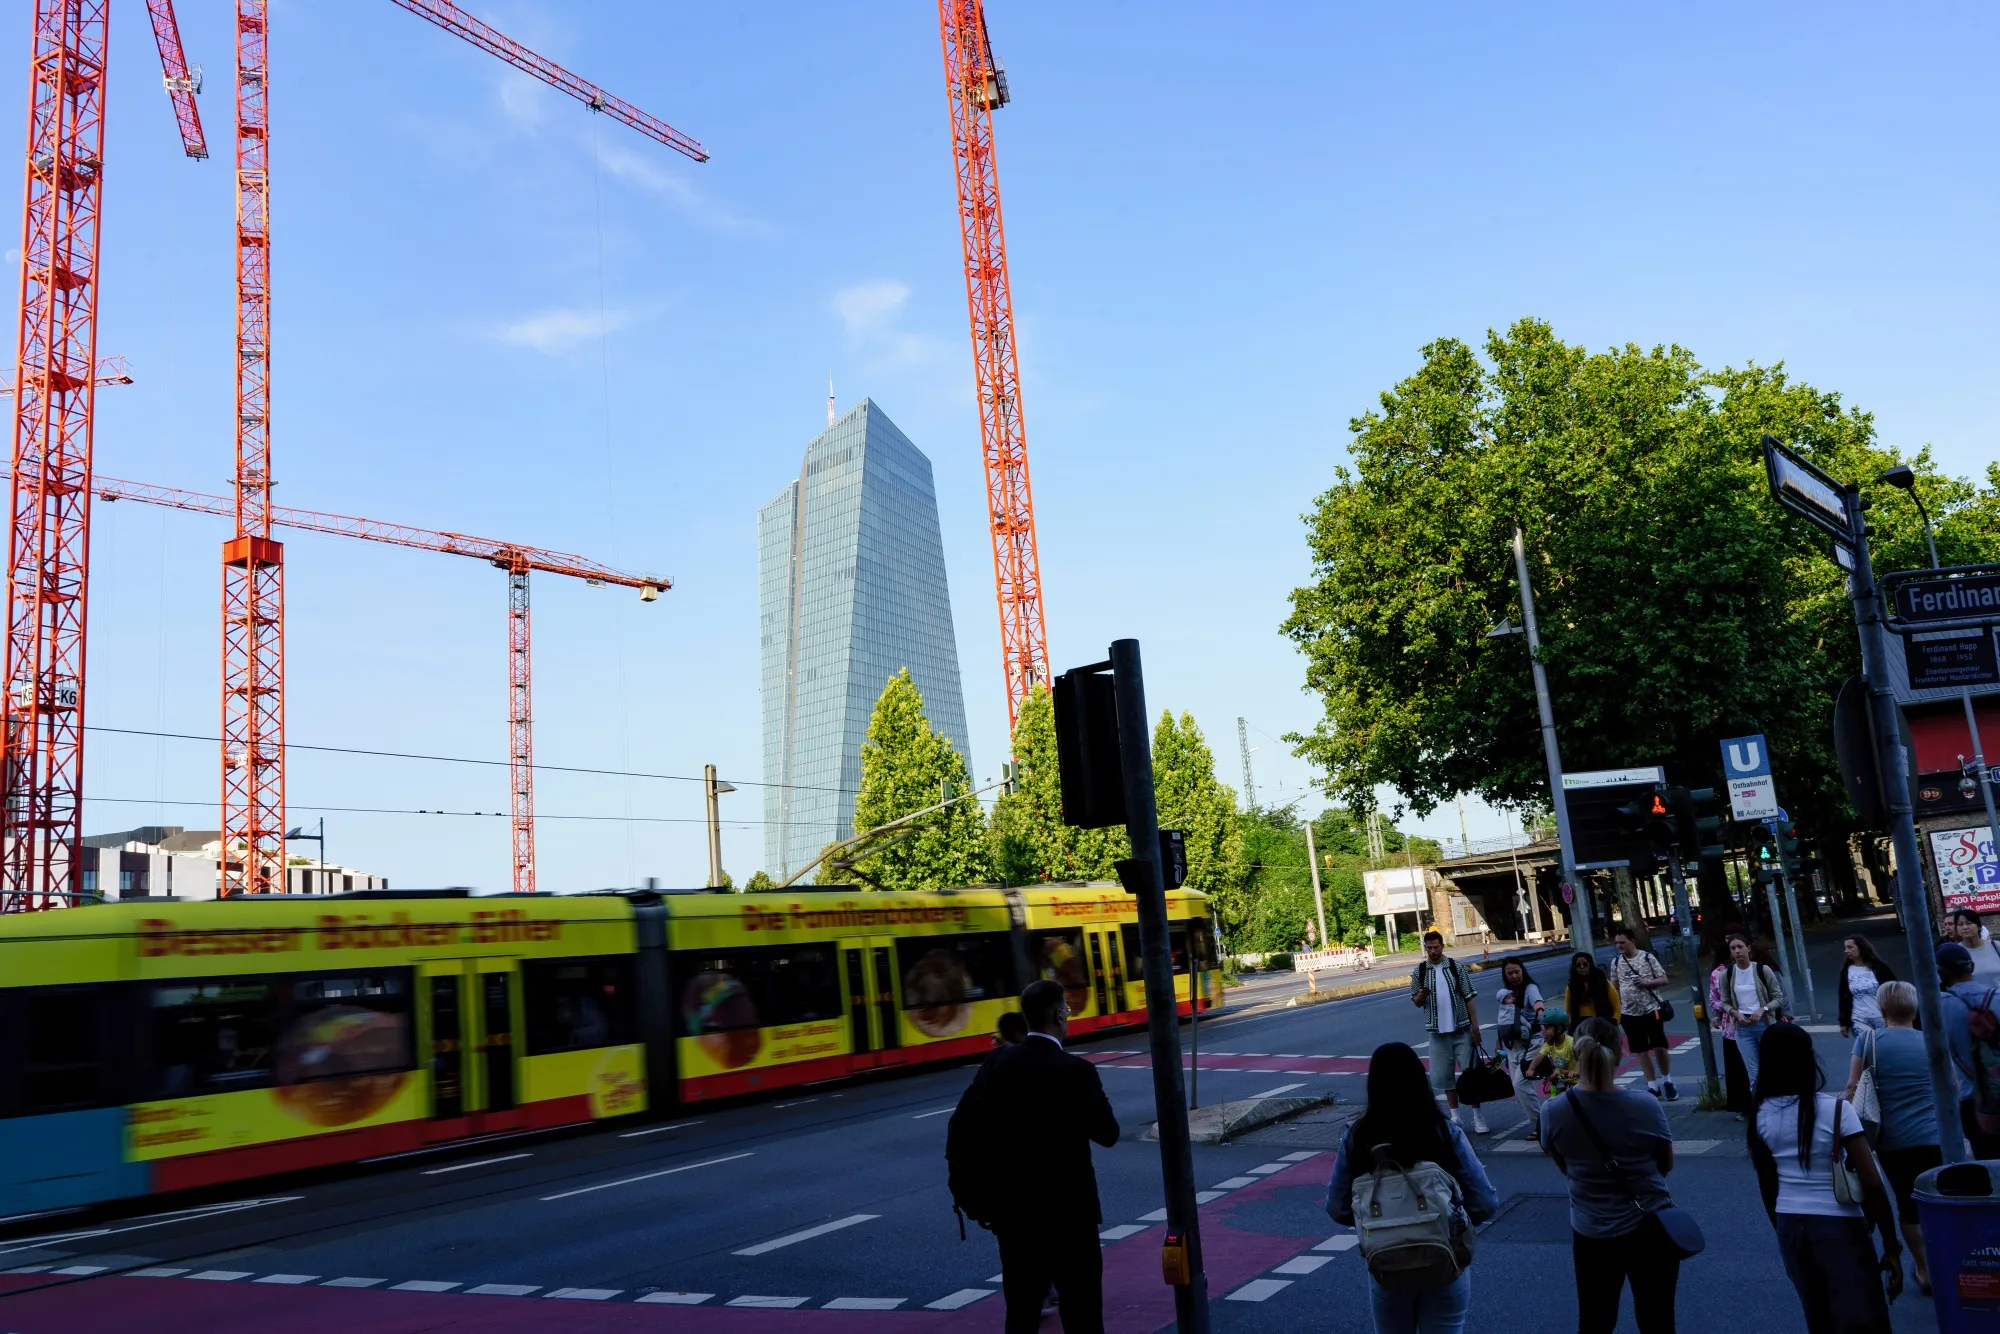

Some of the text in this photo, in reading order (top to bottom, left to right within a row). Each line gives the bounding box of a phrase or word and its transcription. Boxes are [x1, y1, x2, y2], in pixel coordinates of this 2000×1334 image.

[1922, 642, 1978, 653] Ferdinand Happ
[1956, 653, 1973, 661] 1952
[1914, 675, 1948, 684] Frankfurter
[60, 689, 77, 705] K6
[1728, 741, 1761, 772] U
[1732, 779, 1768, 789] Ostbahnhof
[1745, 808, 1767, 816] Aufzug
[741, 903, 786, 931] Die
